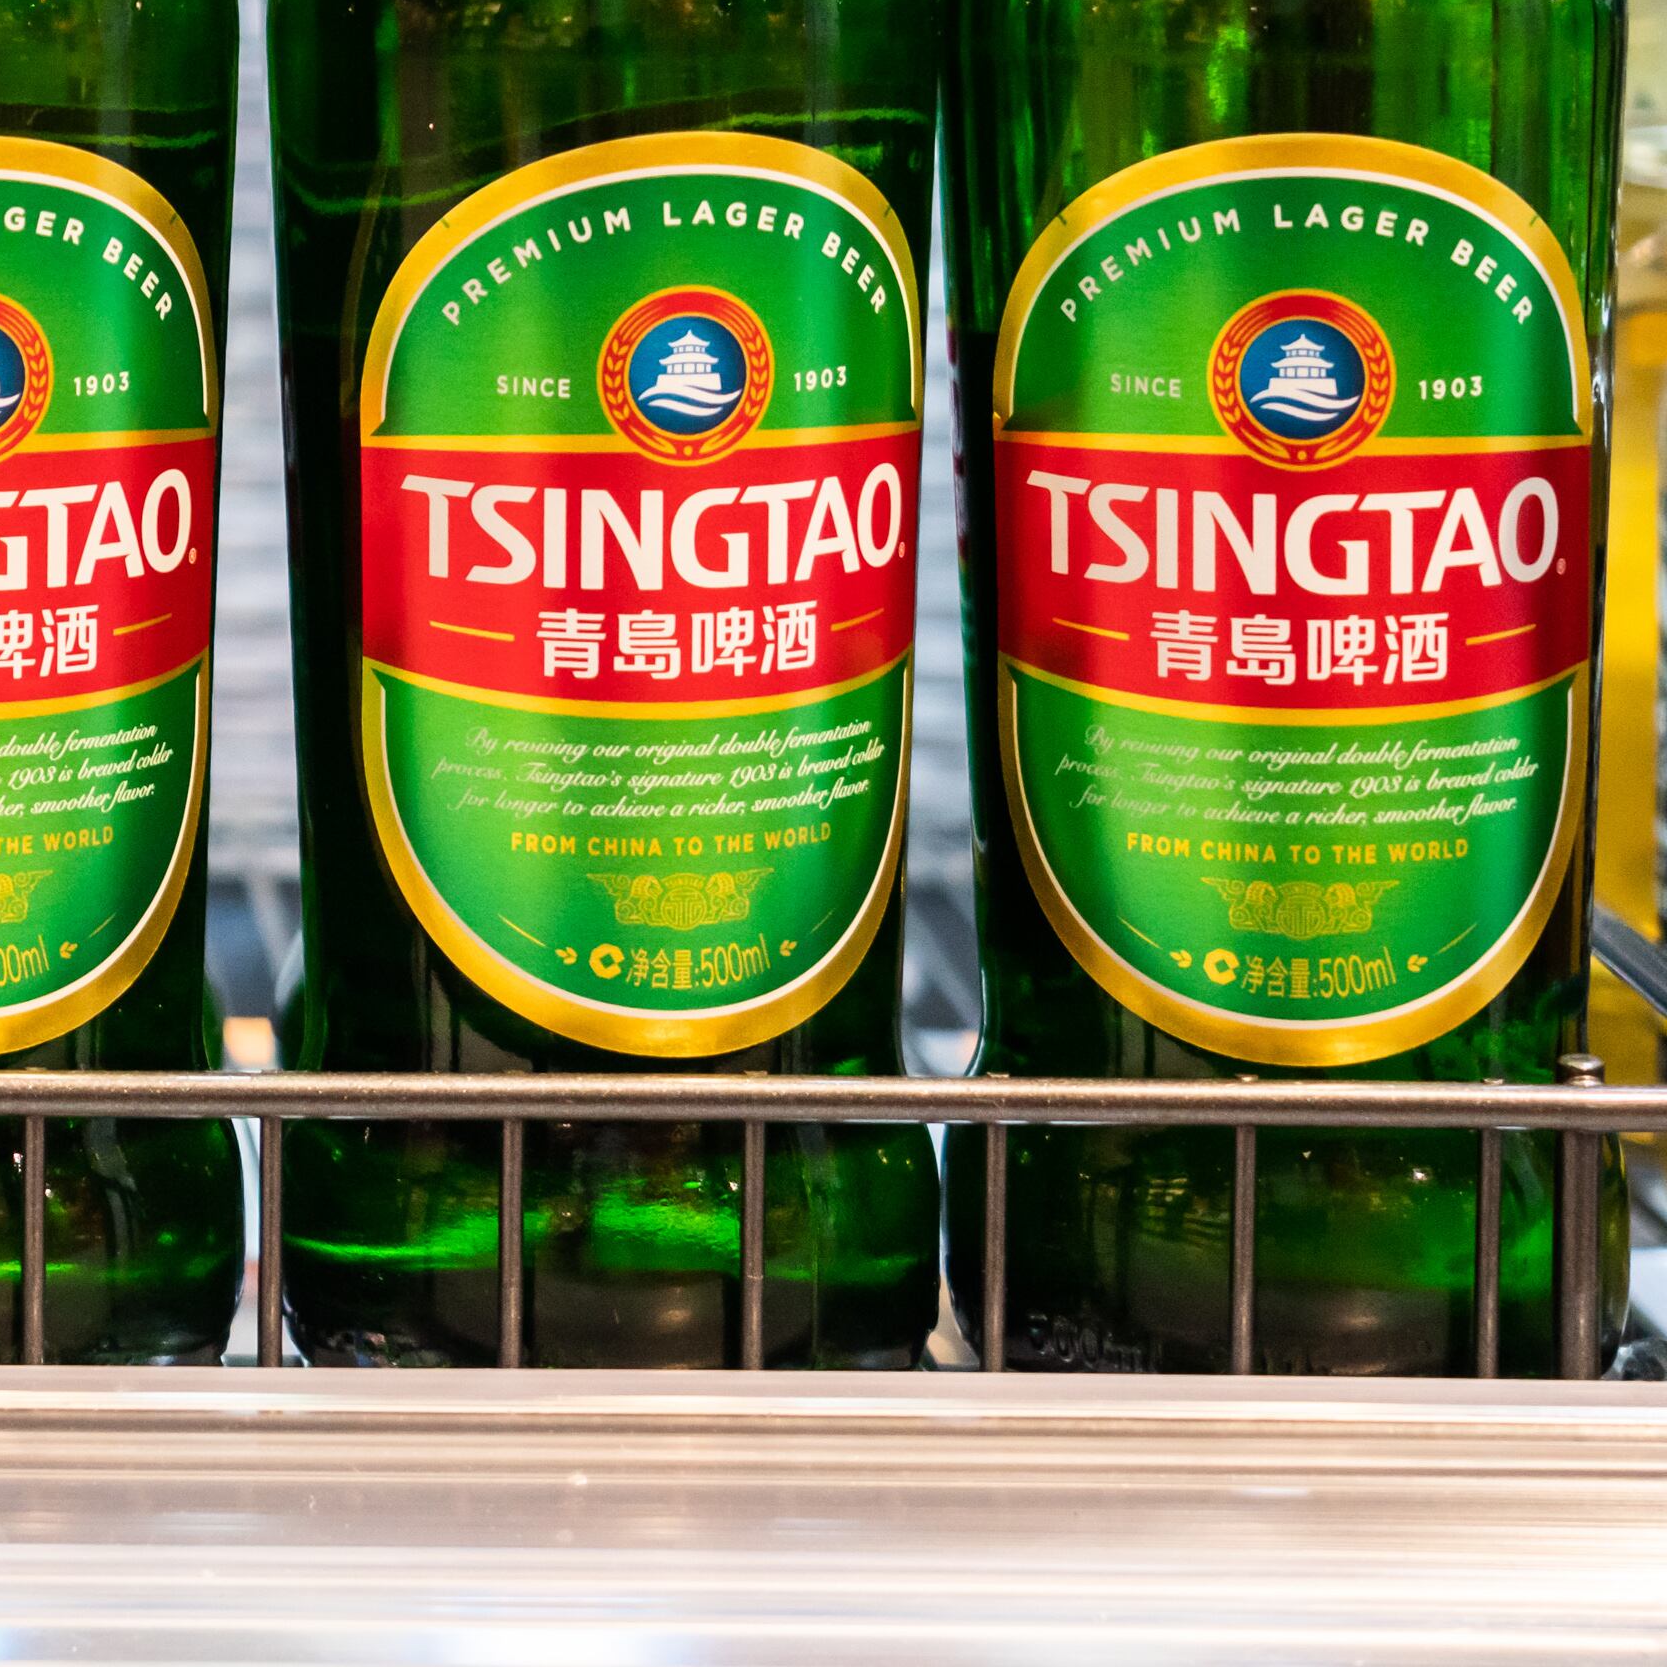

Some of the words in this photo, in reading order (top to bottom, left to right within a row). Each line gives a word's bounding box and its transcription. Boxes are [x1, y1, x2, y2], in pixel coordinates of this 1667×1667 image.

[102, 238, 173, 321] BEER
[442, 207, 631, 326] PREMIUM
[663, 200, 804, 239] LAGER
[821, 232, 885, 315] BEER
[1060, 207, 1241, 324] PREMIUM
[1274, 204, 1429, 246] LAGER
[1450, 240, 1532, 325] BEER
[74, 372, 129, 396] 1903
[497, 375, 570, 398] SINCE
[794, 366, 846, 391] 1903
[1111, 373, 1181, 399] SINCE
[1419, 376, 1482, 400] 1903
[401, 462, 903, 591] TSINGTAO
[1027, 470, 1558, 596] TSINGTAO
[536, 600, 817, 680] 青島啤酒
[1150, 610, 1448, 686] 青島啤酒
[42, 826, 112, 852] WORLD
[511, 831, 575, 854] FROM
[588, 837, 662, 856] CHINA
[674, 836, 703, 856] TO
[714, 833, 754, 854] THE
[764, 823, 830, 850] WORLD
[1127, 832, 1190, 857] FROM
[1200, 839, 1275, 862] CHINA
[1290, 845, 1321, 864] TO
[1332, 844, 1376, 864] THE
[1387, 839, 1467, 864] WORLD
